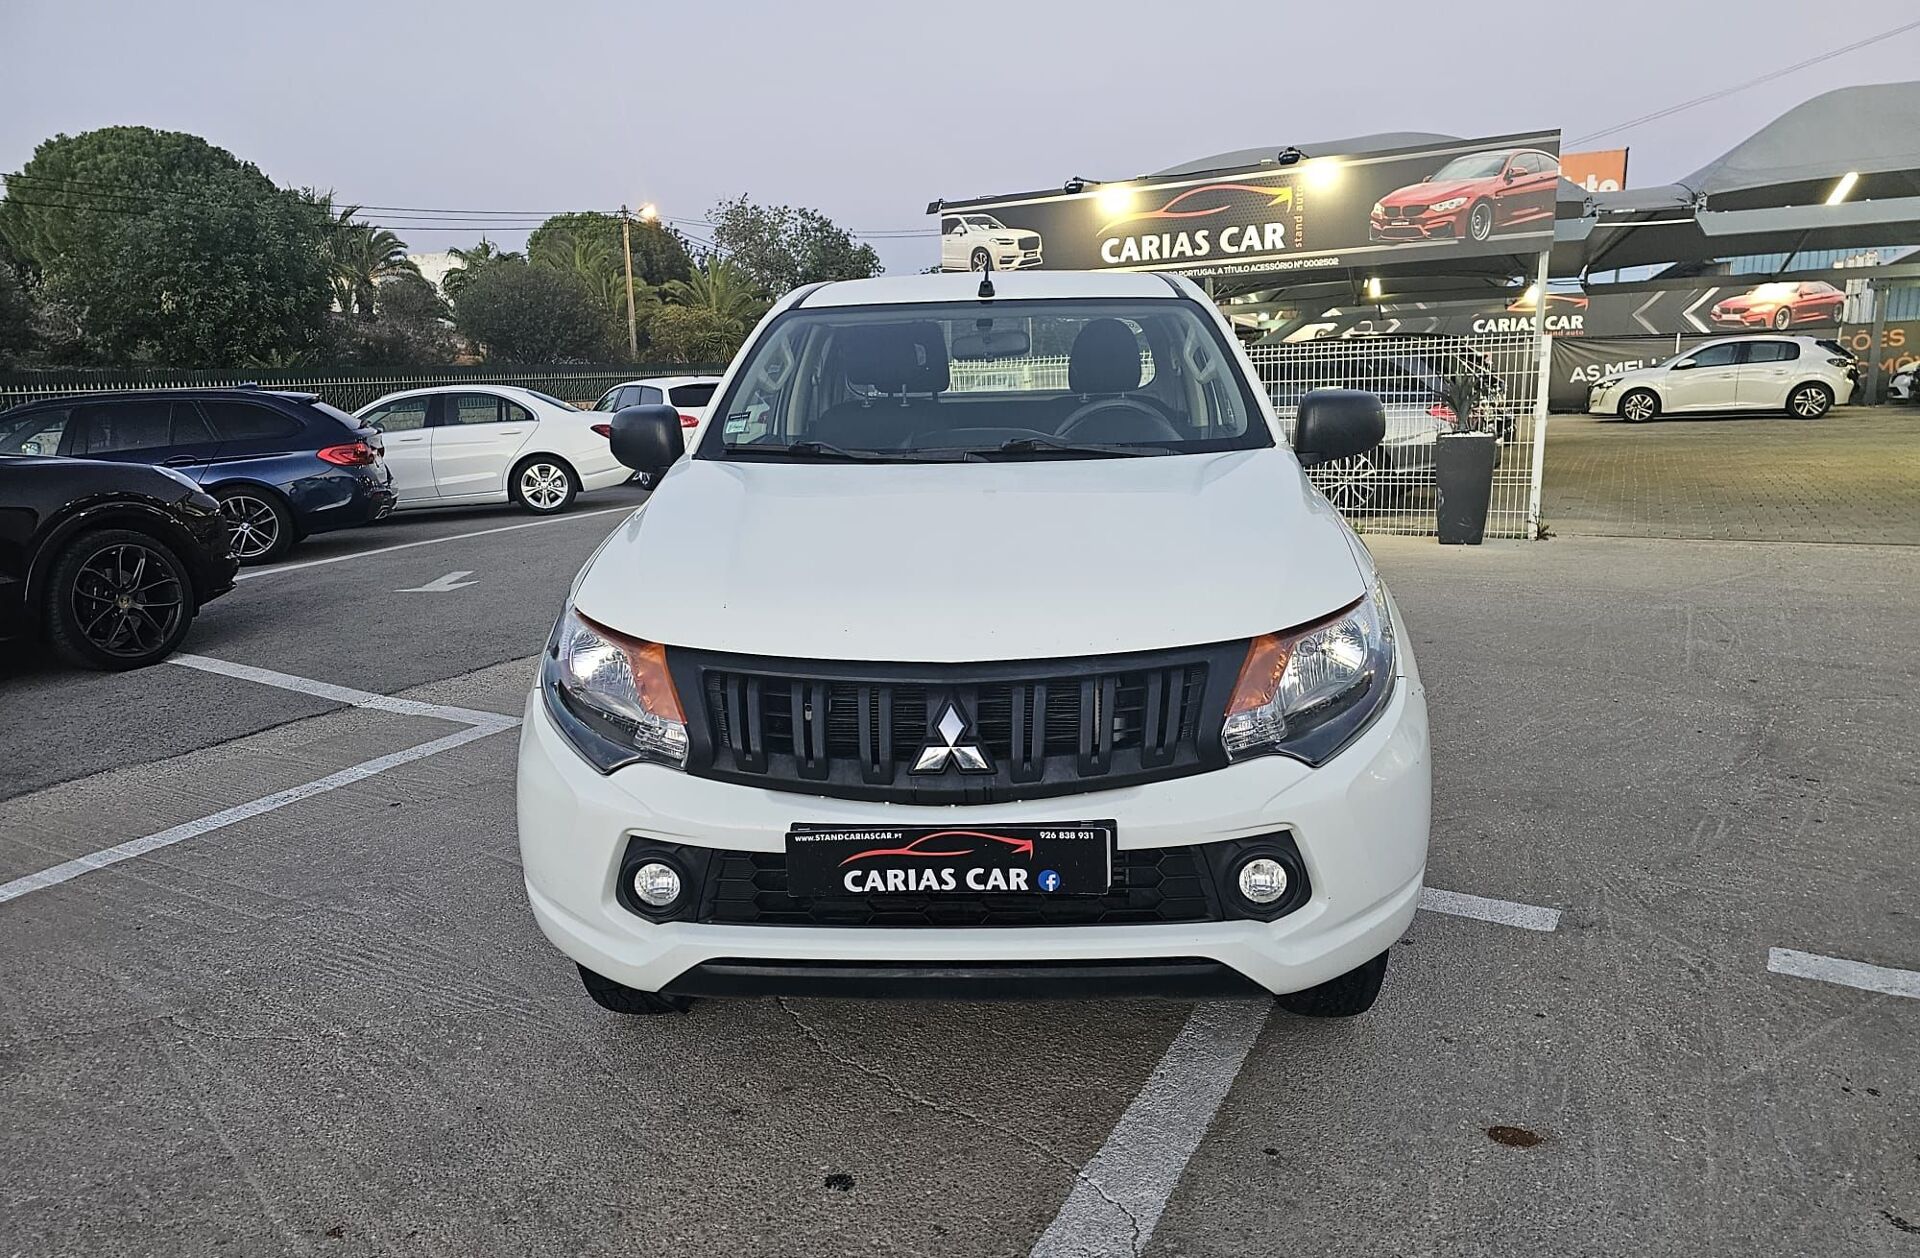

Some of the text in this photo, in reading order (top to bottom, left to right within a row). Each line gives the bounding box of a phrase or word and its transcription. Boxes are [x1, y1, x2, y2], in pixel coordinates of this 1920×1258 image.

[1294, 185, 1304, 248] stand auto
[1101, 222, 1286, 263] CARIAS CAR
[1178, 268, 1217, 276] PORTUGAL
[1217, 267, 1223, 275] A
[1223, 264, 1250, 274] TÍTULO
[1250, 261, 1294, 272] ACESSÓRIO
[1544, 315, 1584, 330] CAR
[1570, 364, 1600, 383] AS
[1039, 831, 1094, 840] 926 838 931
[843, 868, 957, 893] CARIAS
[966, 868, 1029, 891] CAR
